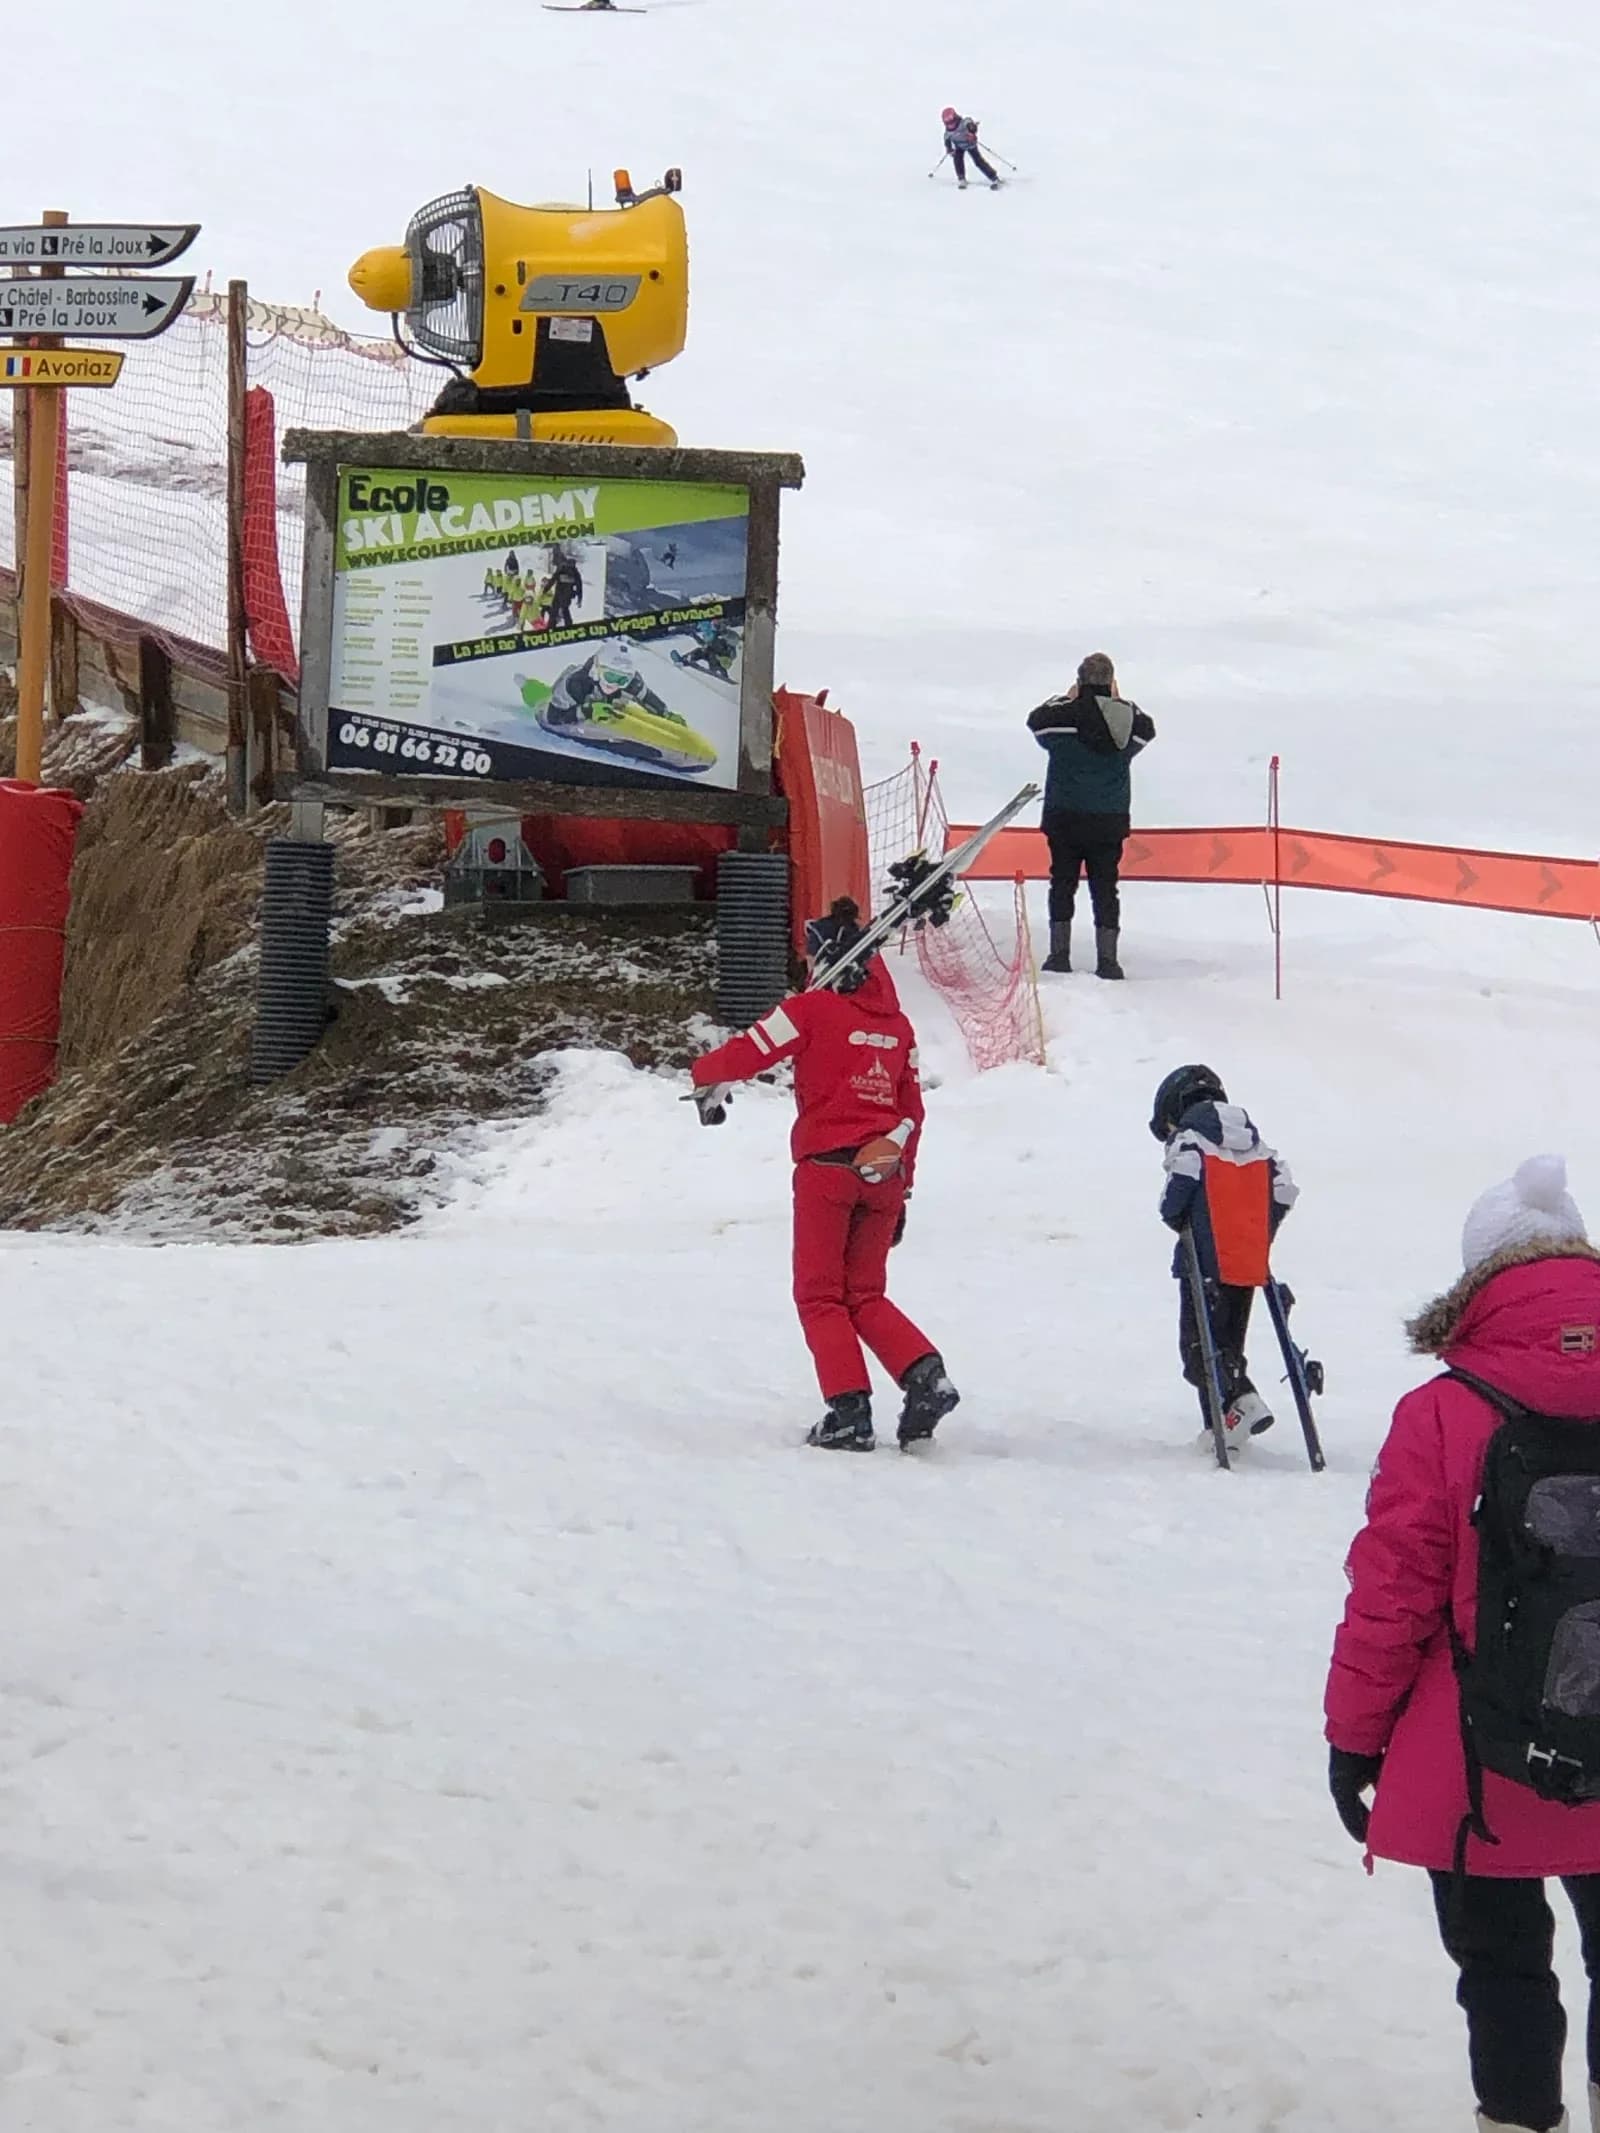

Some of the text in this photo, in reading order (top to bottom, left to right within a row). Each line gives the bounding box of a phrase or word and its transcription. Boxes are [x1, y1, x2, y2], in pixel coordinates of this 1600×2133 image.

[13, 237, 35, 255] via
[62, 234, 85, 254] Pré
[89, 237, 103, 254] la
[108, 236, 143, 255] Joux
[7, 287, 52, 306] Châtel
[66, 287, 139, 306] Barbossine
[557, 284, 628, 304] T40
[18, 307, 117, 327] Pré la Joux
[36, 358, 112, 377] Avoriaz
[349, 474, 450, 514] Ecole
[343, 486, 600, 551] SKI ACADEMY
[345, 522, 596, 569] WWW.ECOLESKIACADEMY.COM
[589, 624, 608, 636] un
[339, 723, 370, 748] 06
[373, 731, 398, 754] 81
[400, 737, 431, 761] 66
[433, 744, 458, 767] 52
[461, 750, 492, 774] 80
